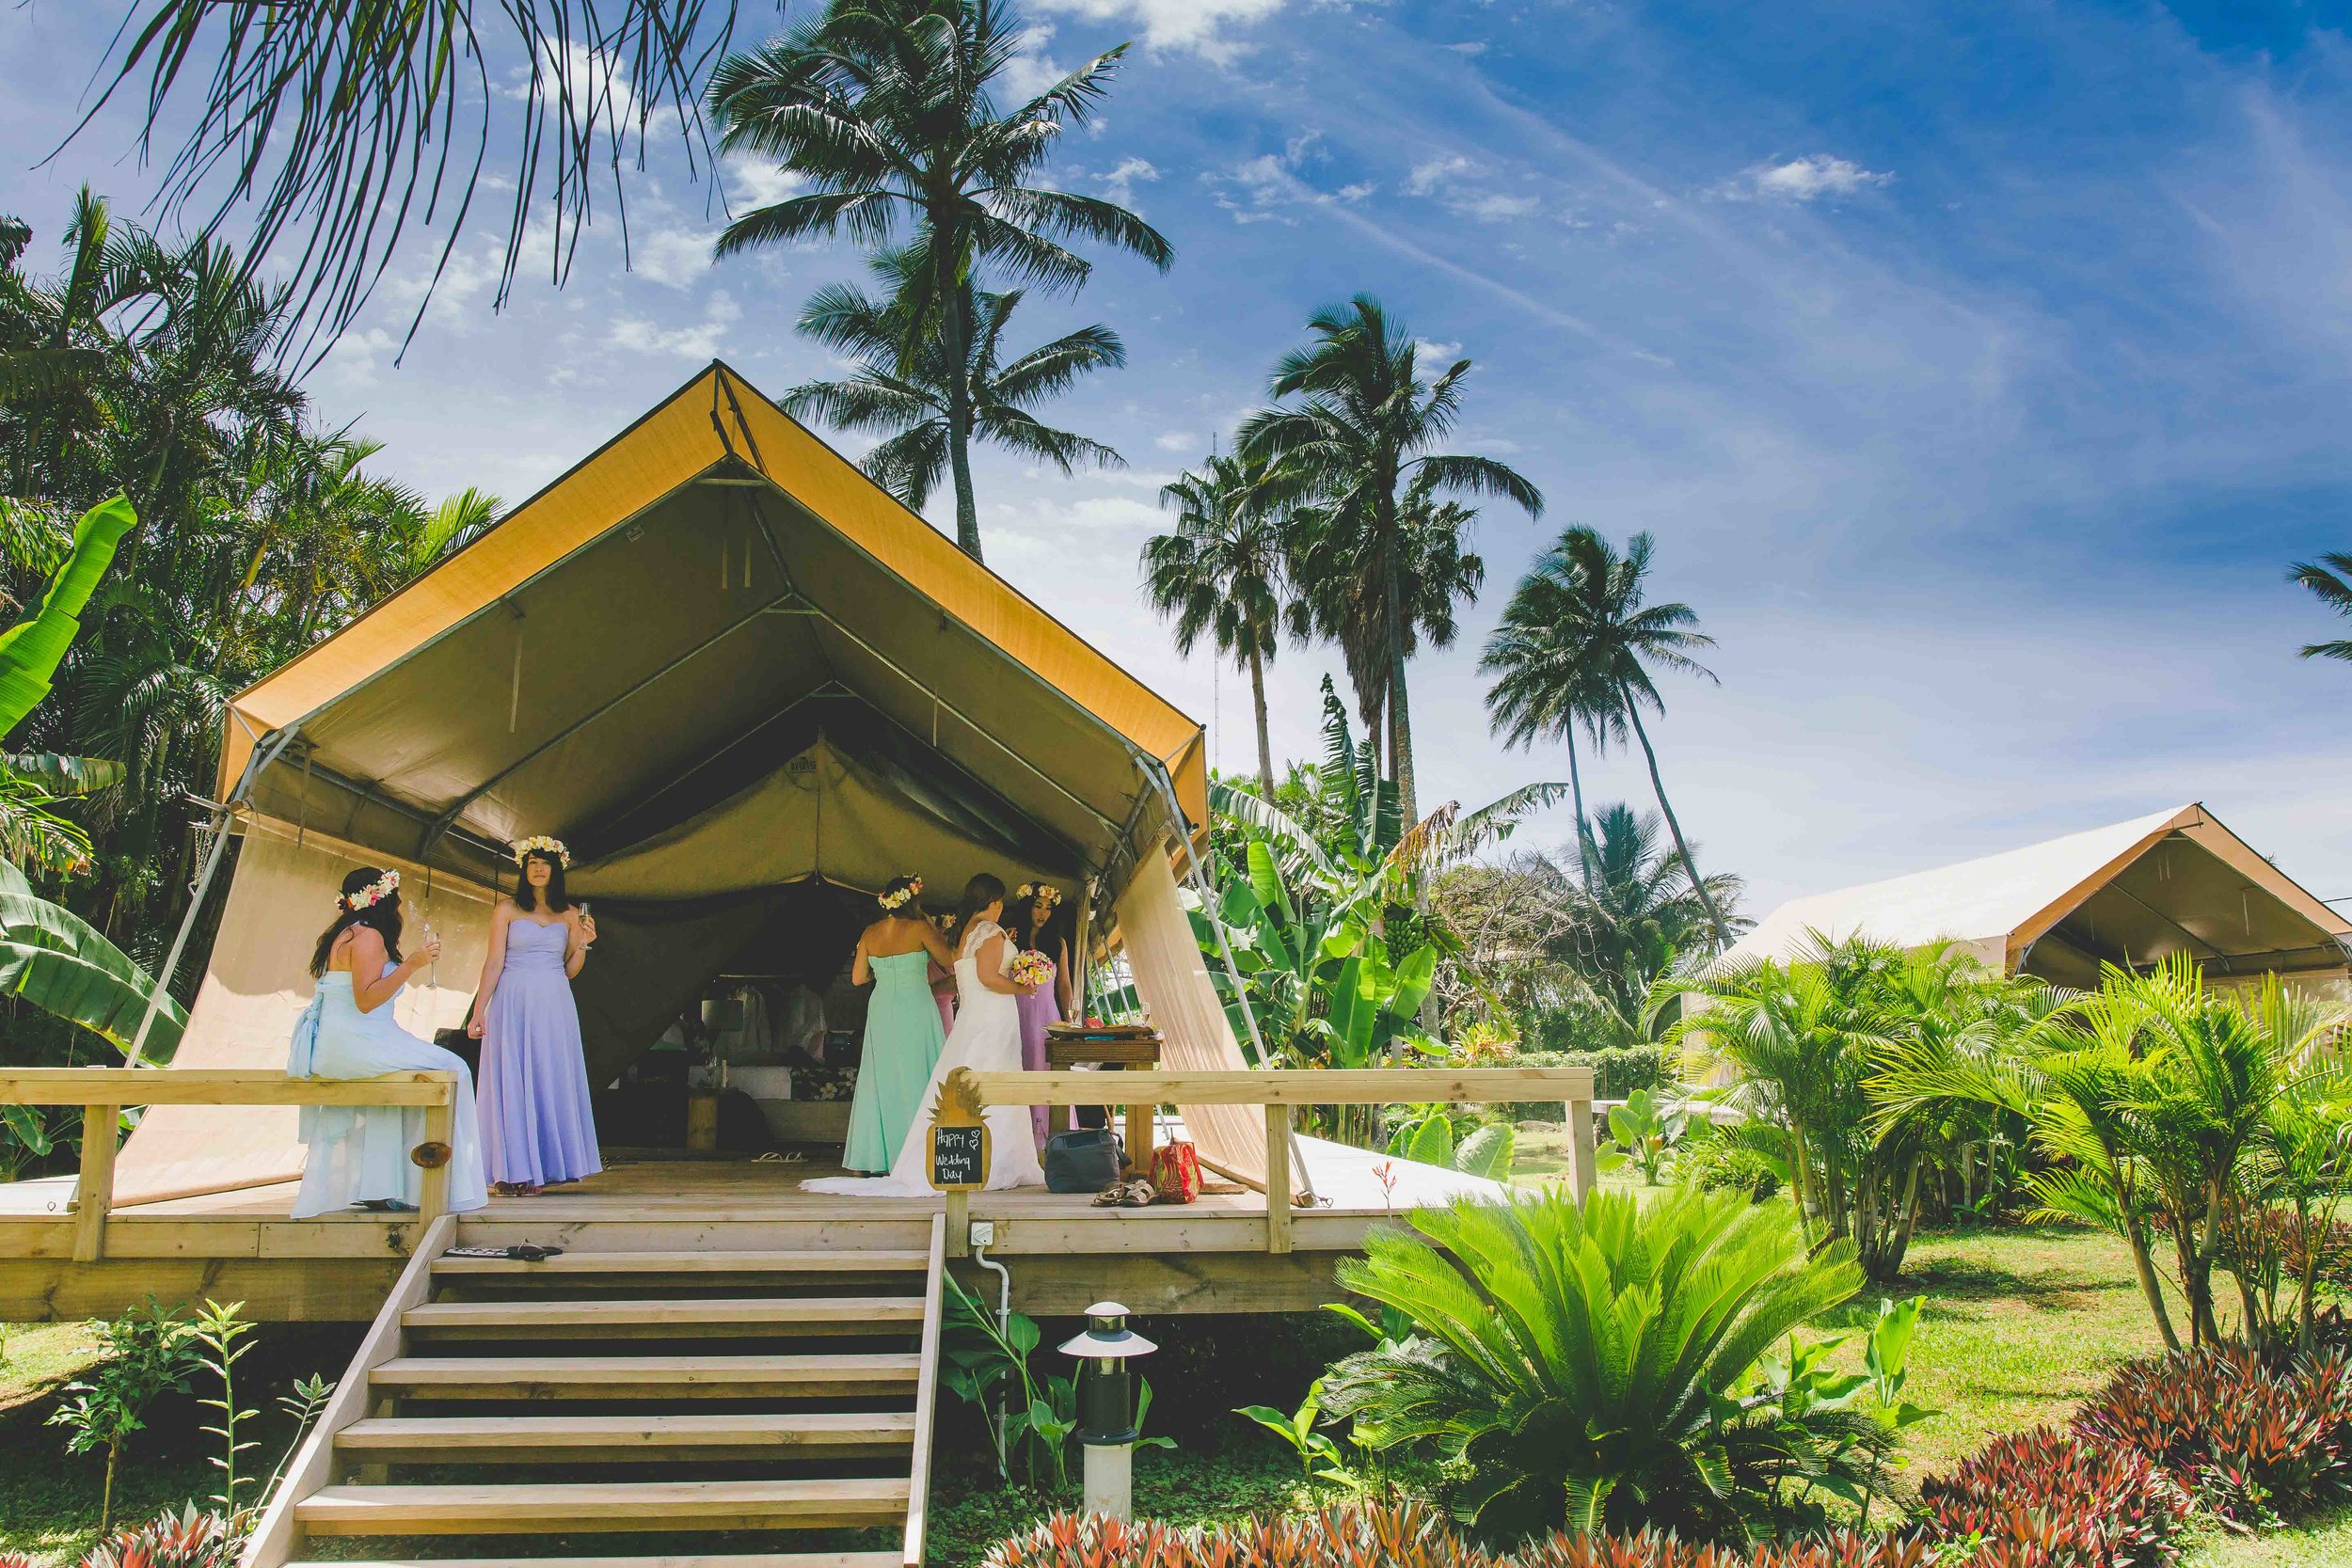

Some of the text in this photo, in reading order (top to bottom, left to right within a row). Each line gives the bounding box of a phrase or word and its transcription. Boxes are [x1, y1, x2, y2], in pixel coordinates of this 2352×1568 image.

[936, 1127, 964, 1148] Happy
[935, 1153, 970, 1170] Wedding
[942, 1168, 962, 1184] Day
